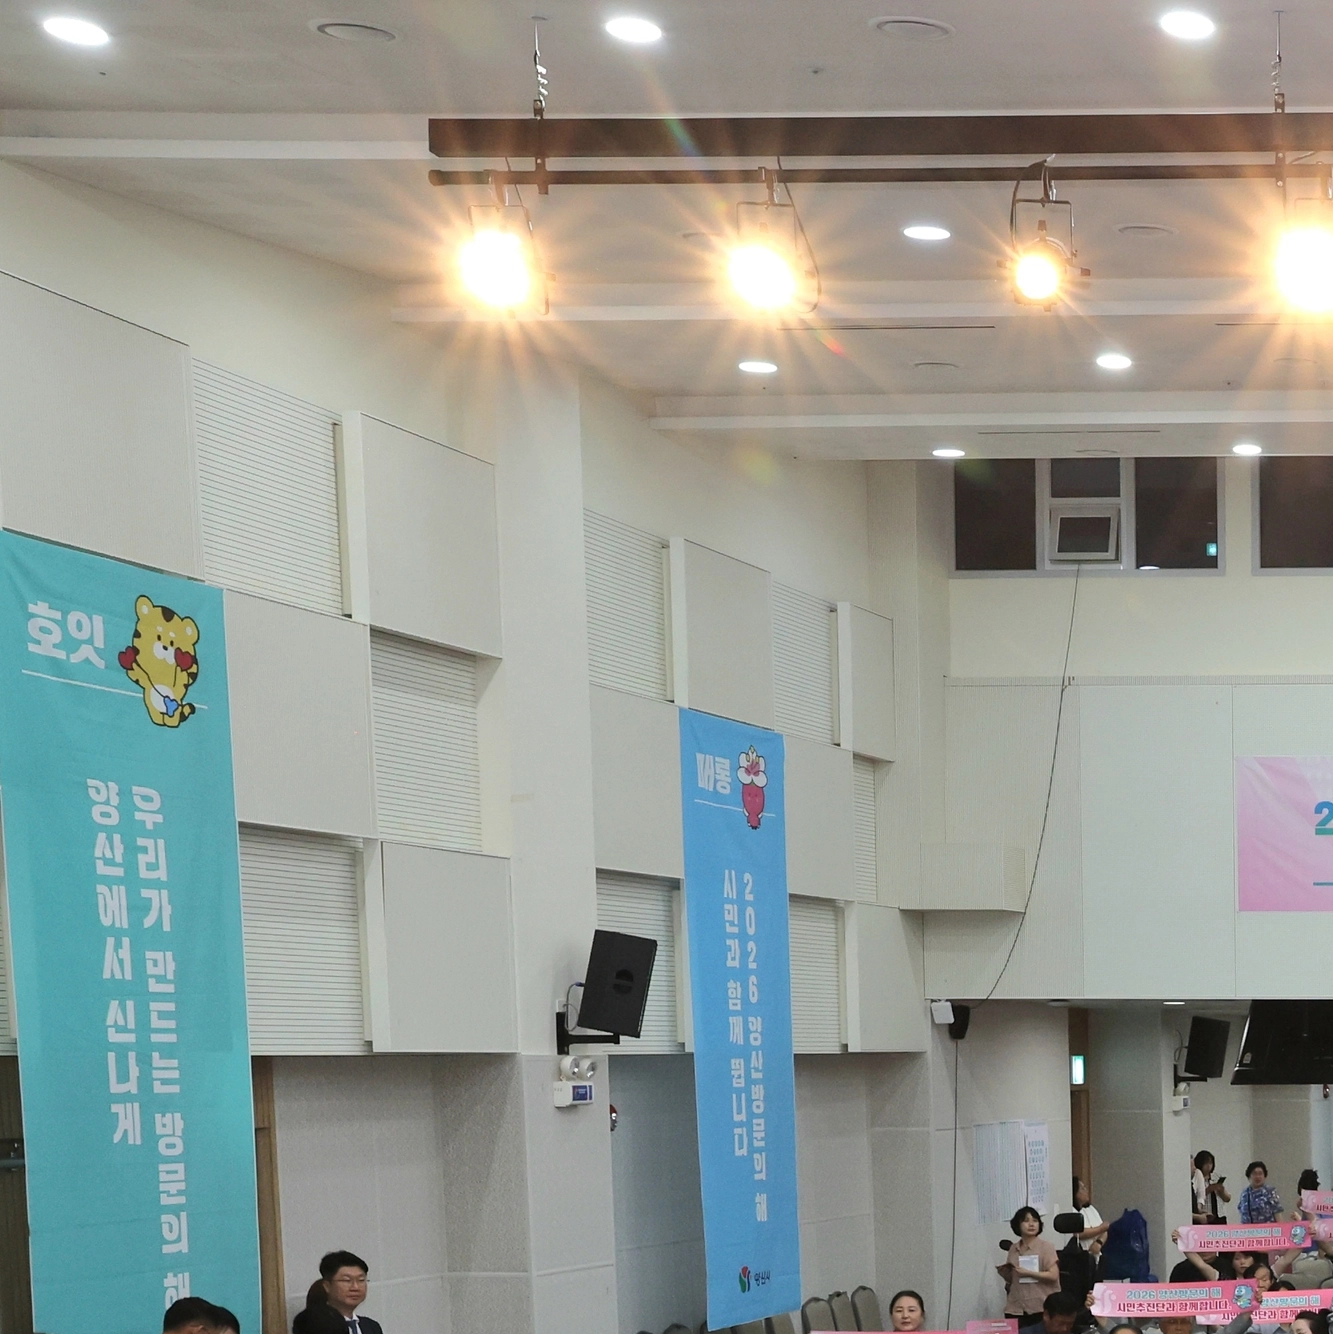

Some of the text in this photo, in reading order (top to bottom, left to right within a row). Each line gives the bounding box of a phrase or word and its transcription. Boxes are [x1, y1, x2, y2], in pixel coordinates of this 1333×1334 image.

[26, 599, 107, 670] 호잇
[130, 786, 172, 935] 우리가
[722, 869, 741, 969] 시민과
[86, 777, 142, 1148] 양산에서 신나게
[144, 947, 181, 1095] 만드는
[727, 980, 745, 1045] 함께
[743, 872, 768, 1222] 2026 양산방문의 해
[154, 1112, 189, 1256] 방문의
